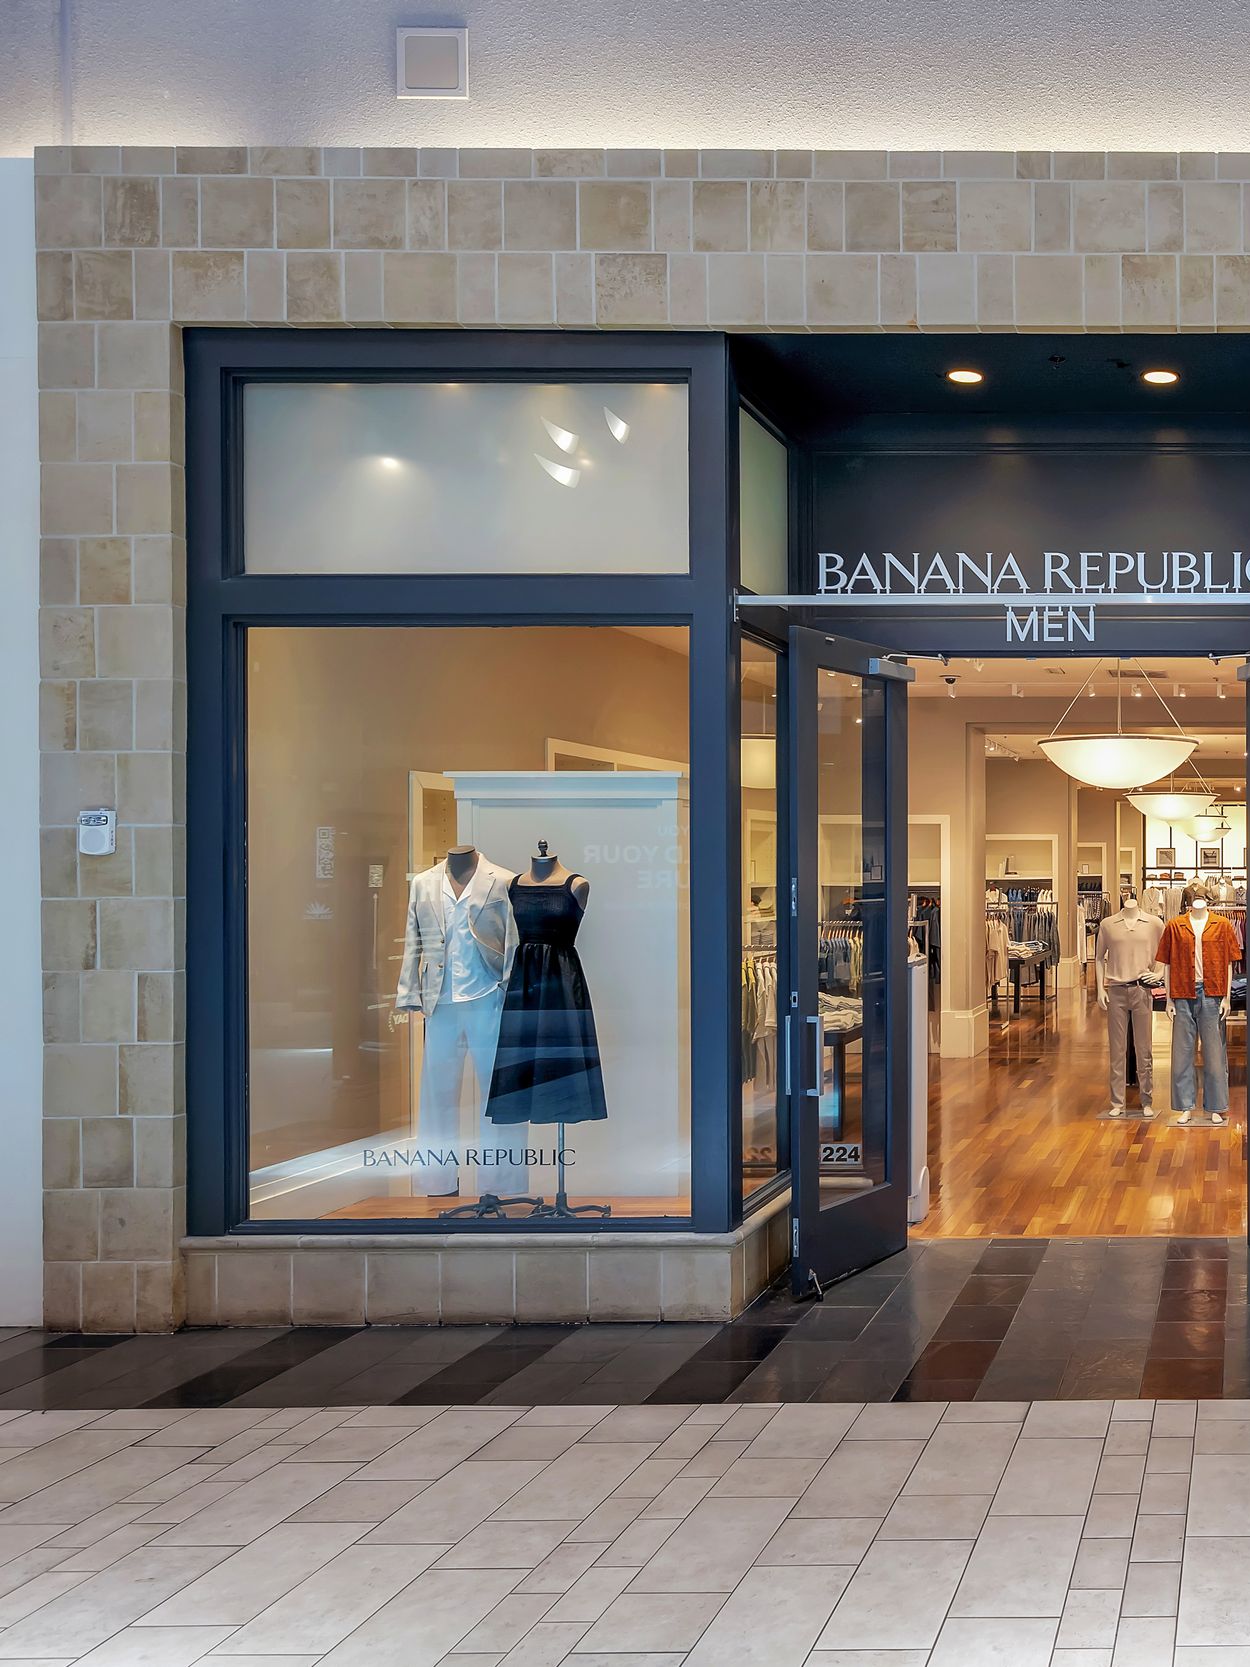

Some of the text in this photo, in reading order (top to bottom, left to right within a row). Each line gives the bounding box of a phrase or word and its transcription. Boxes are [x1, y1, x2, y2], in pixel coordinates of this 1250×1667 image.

[817, 552, 1031, 592] BANANA
[1005, 606, 1096, 642] MEN
[363, 1148, 576, 1167] BANANA REPUBLIC
[822, 1146, 860, 1162] 224
